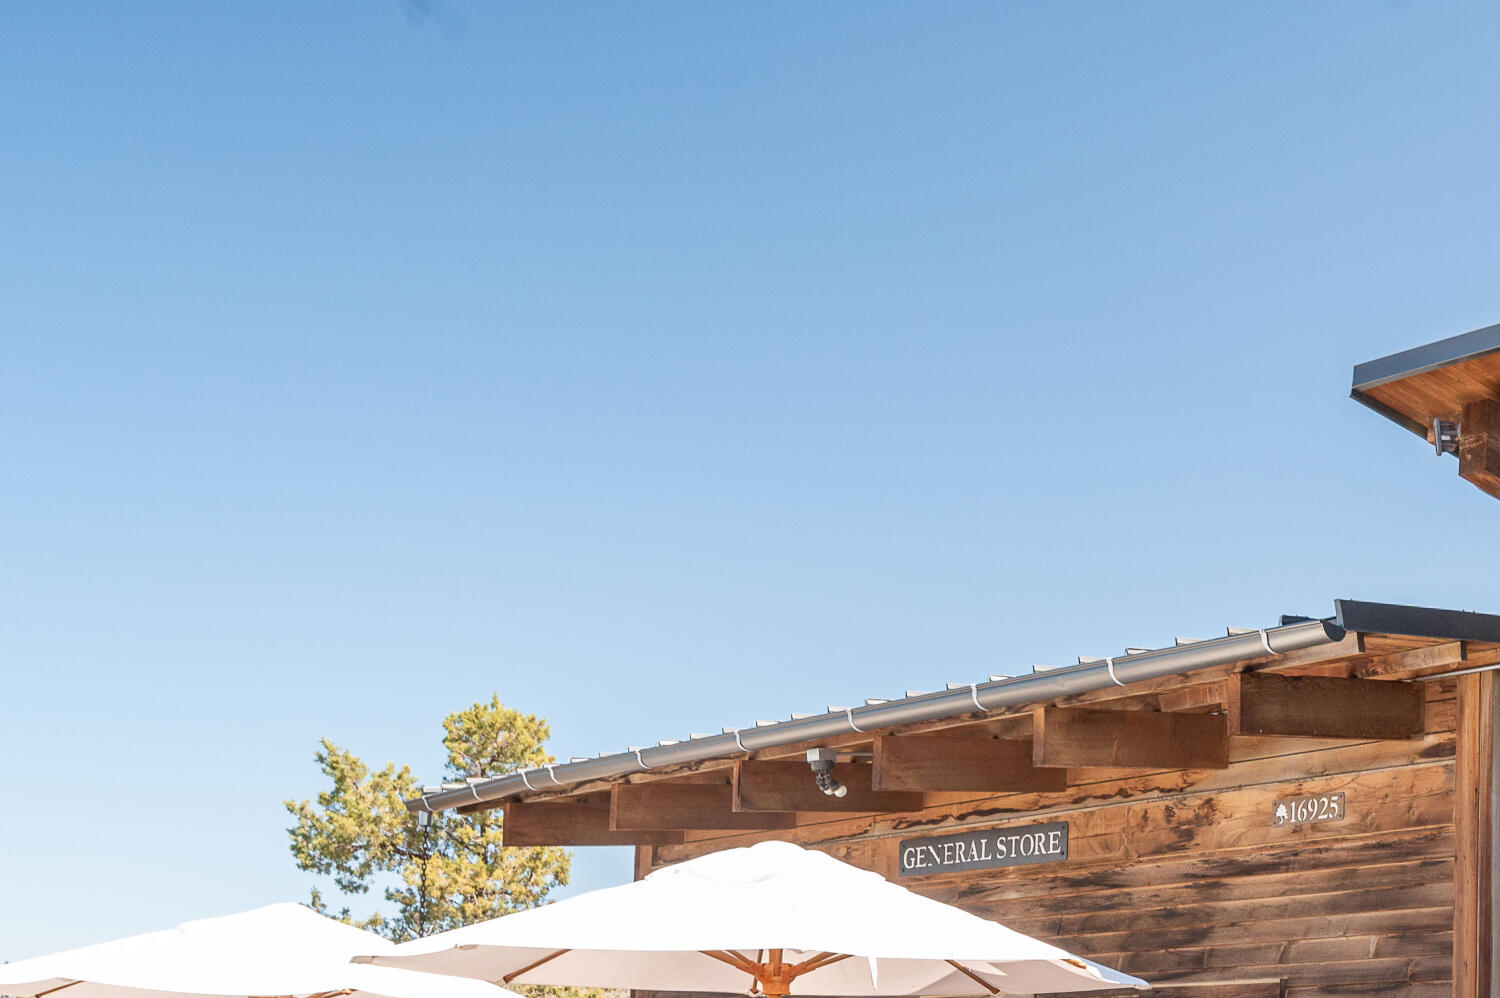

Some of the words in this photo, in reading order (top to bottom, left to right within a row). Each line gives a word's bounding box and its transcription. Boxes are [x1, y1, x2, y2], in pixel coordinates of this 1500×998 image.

[1290, 796, 1339, 823] 16925
[903, 839, 992, 869] GENERAL
[996, 831, 1061, 859] STORE
